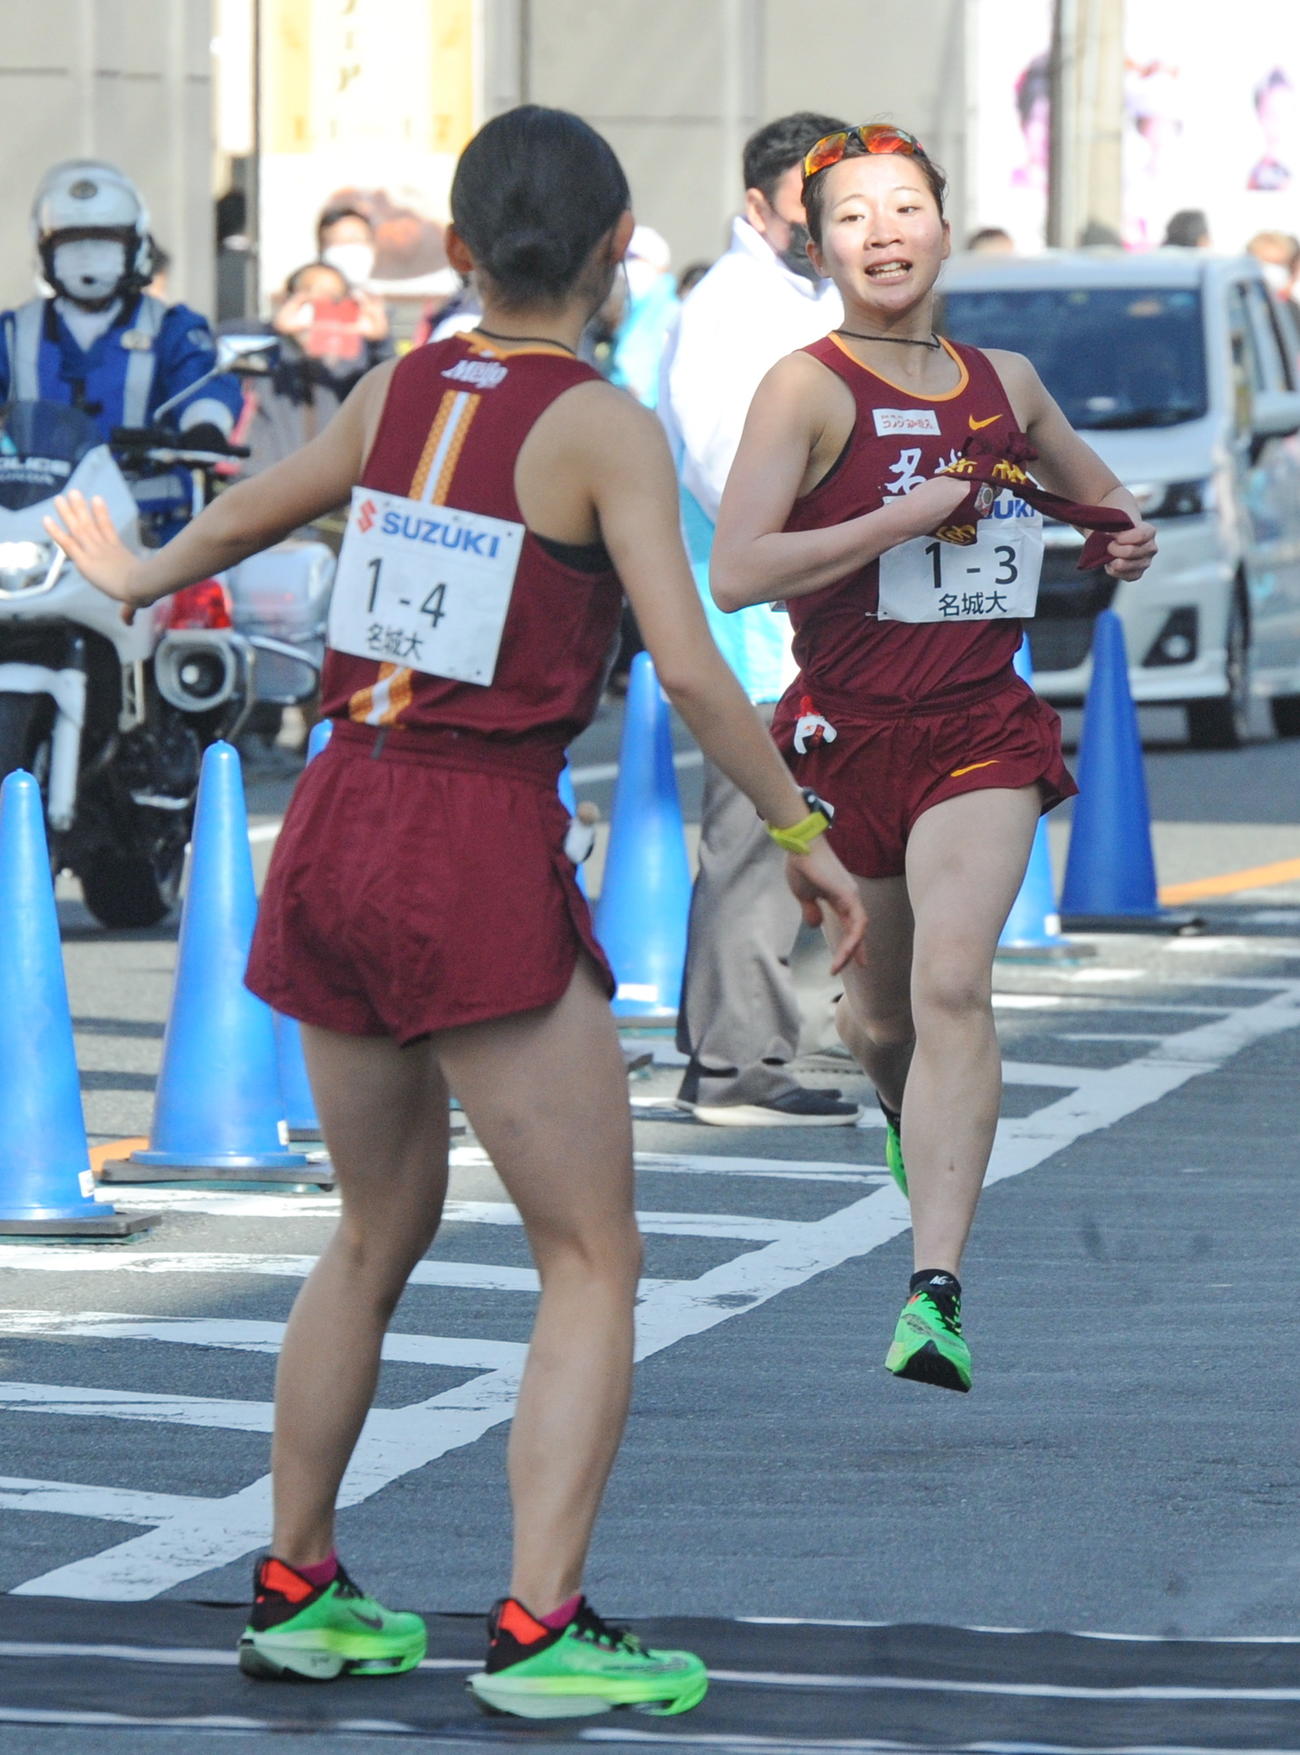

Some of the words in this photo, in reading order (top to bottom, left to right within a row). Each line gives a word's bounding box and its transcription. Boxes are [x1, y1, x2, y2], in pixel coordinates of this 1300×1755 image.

[381, 511, 501, 558] SUZUKI
[938, 591, 1008, 617] 名城大
[367, 623, 424, 661] 名城大
